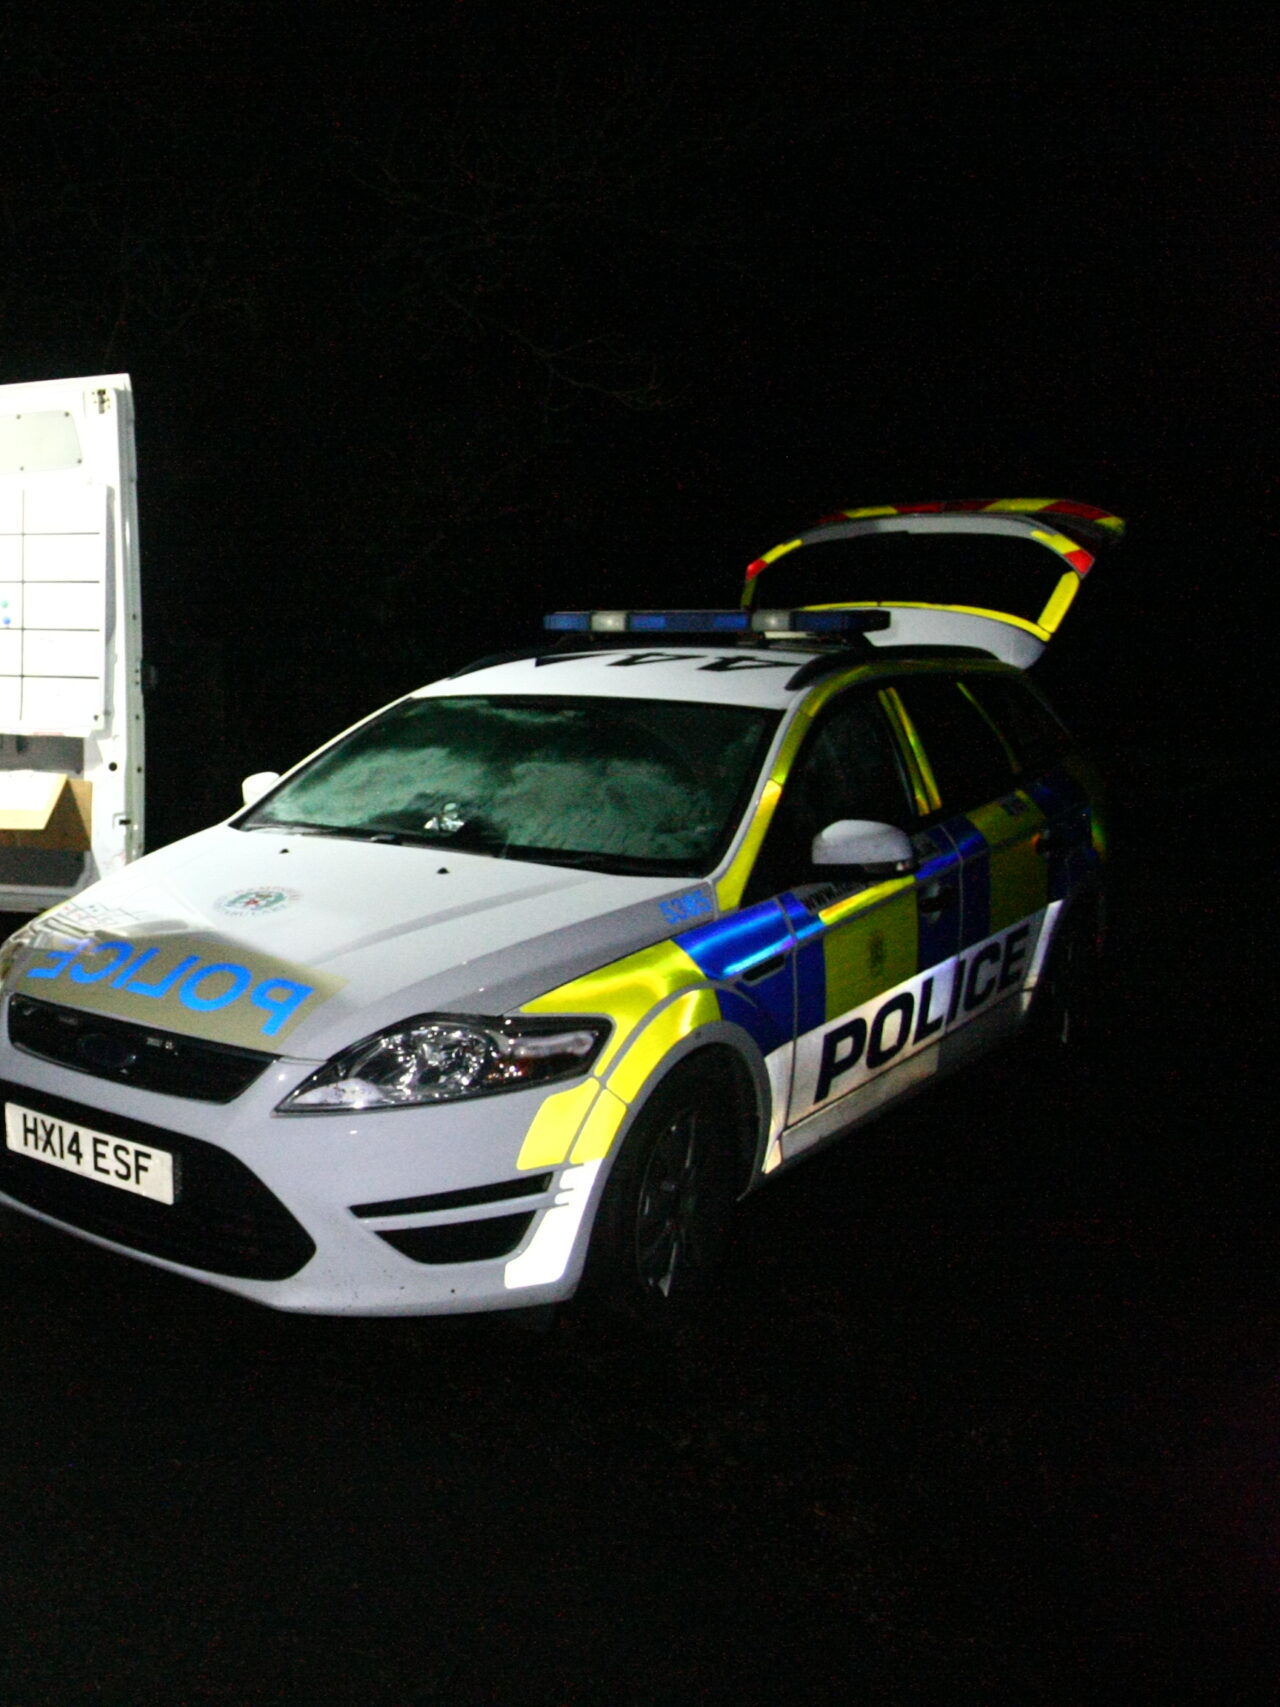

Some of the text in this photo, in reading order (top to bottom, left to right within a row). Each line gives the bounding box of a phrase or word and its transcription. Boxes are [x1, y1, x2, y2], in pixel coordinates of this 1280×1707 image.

[813, 924, 1030, 1105] POLICE
[23, 1113, 152, 1186] HX14 ESF
